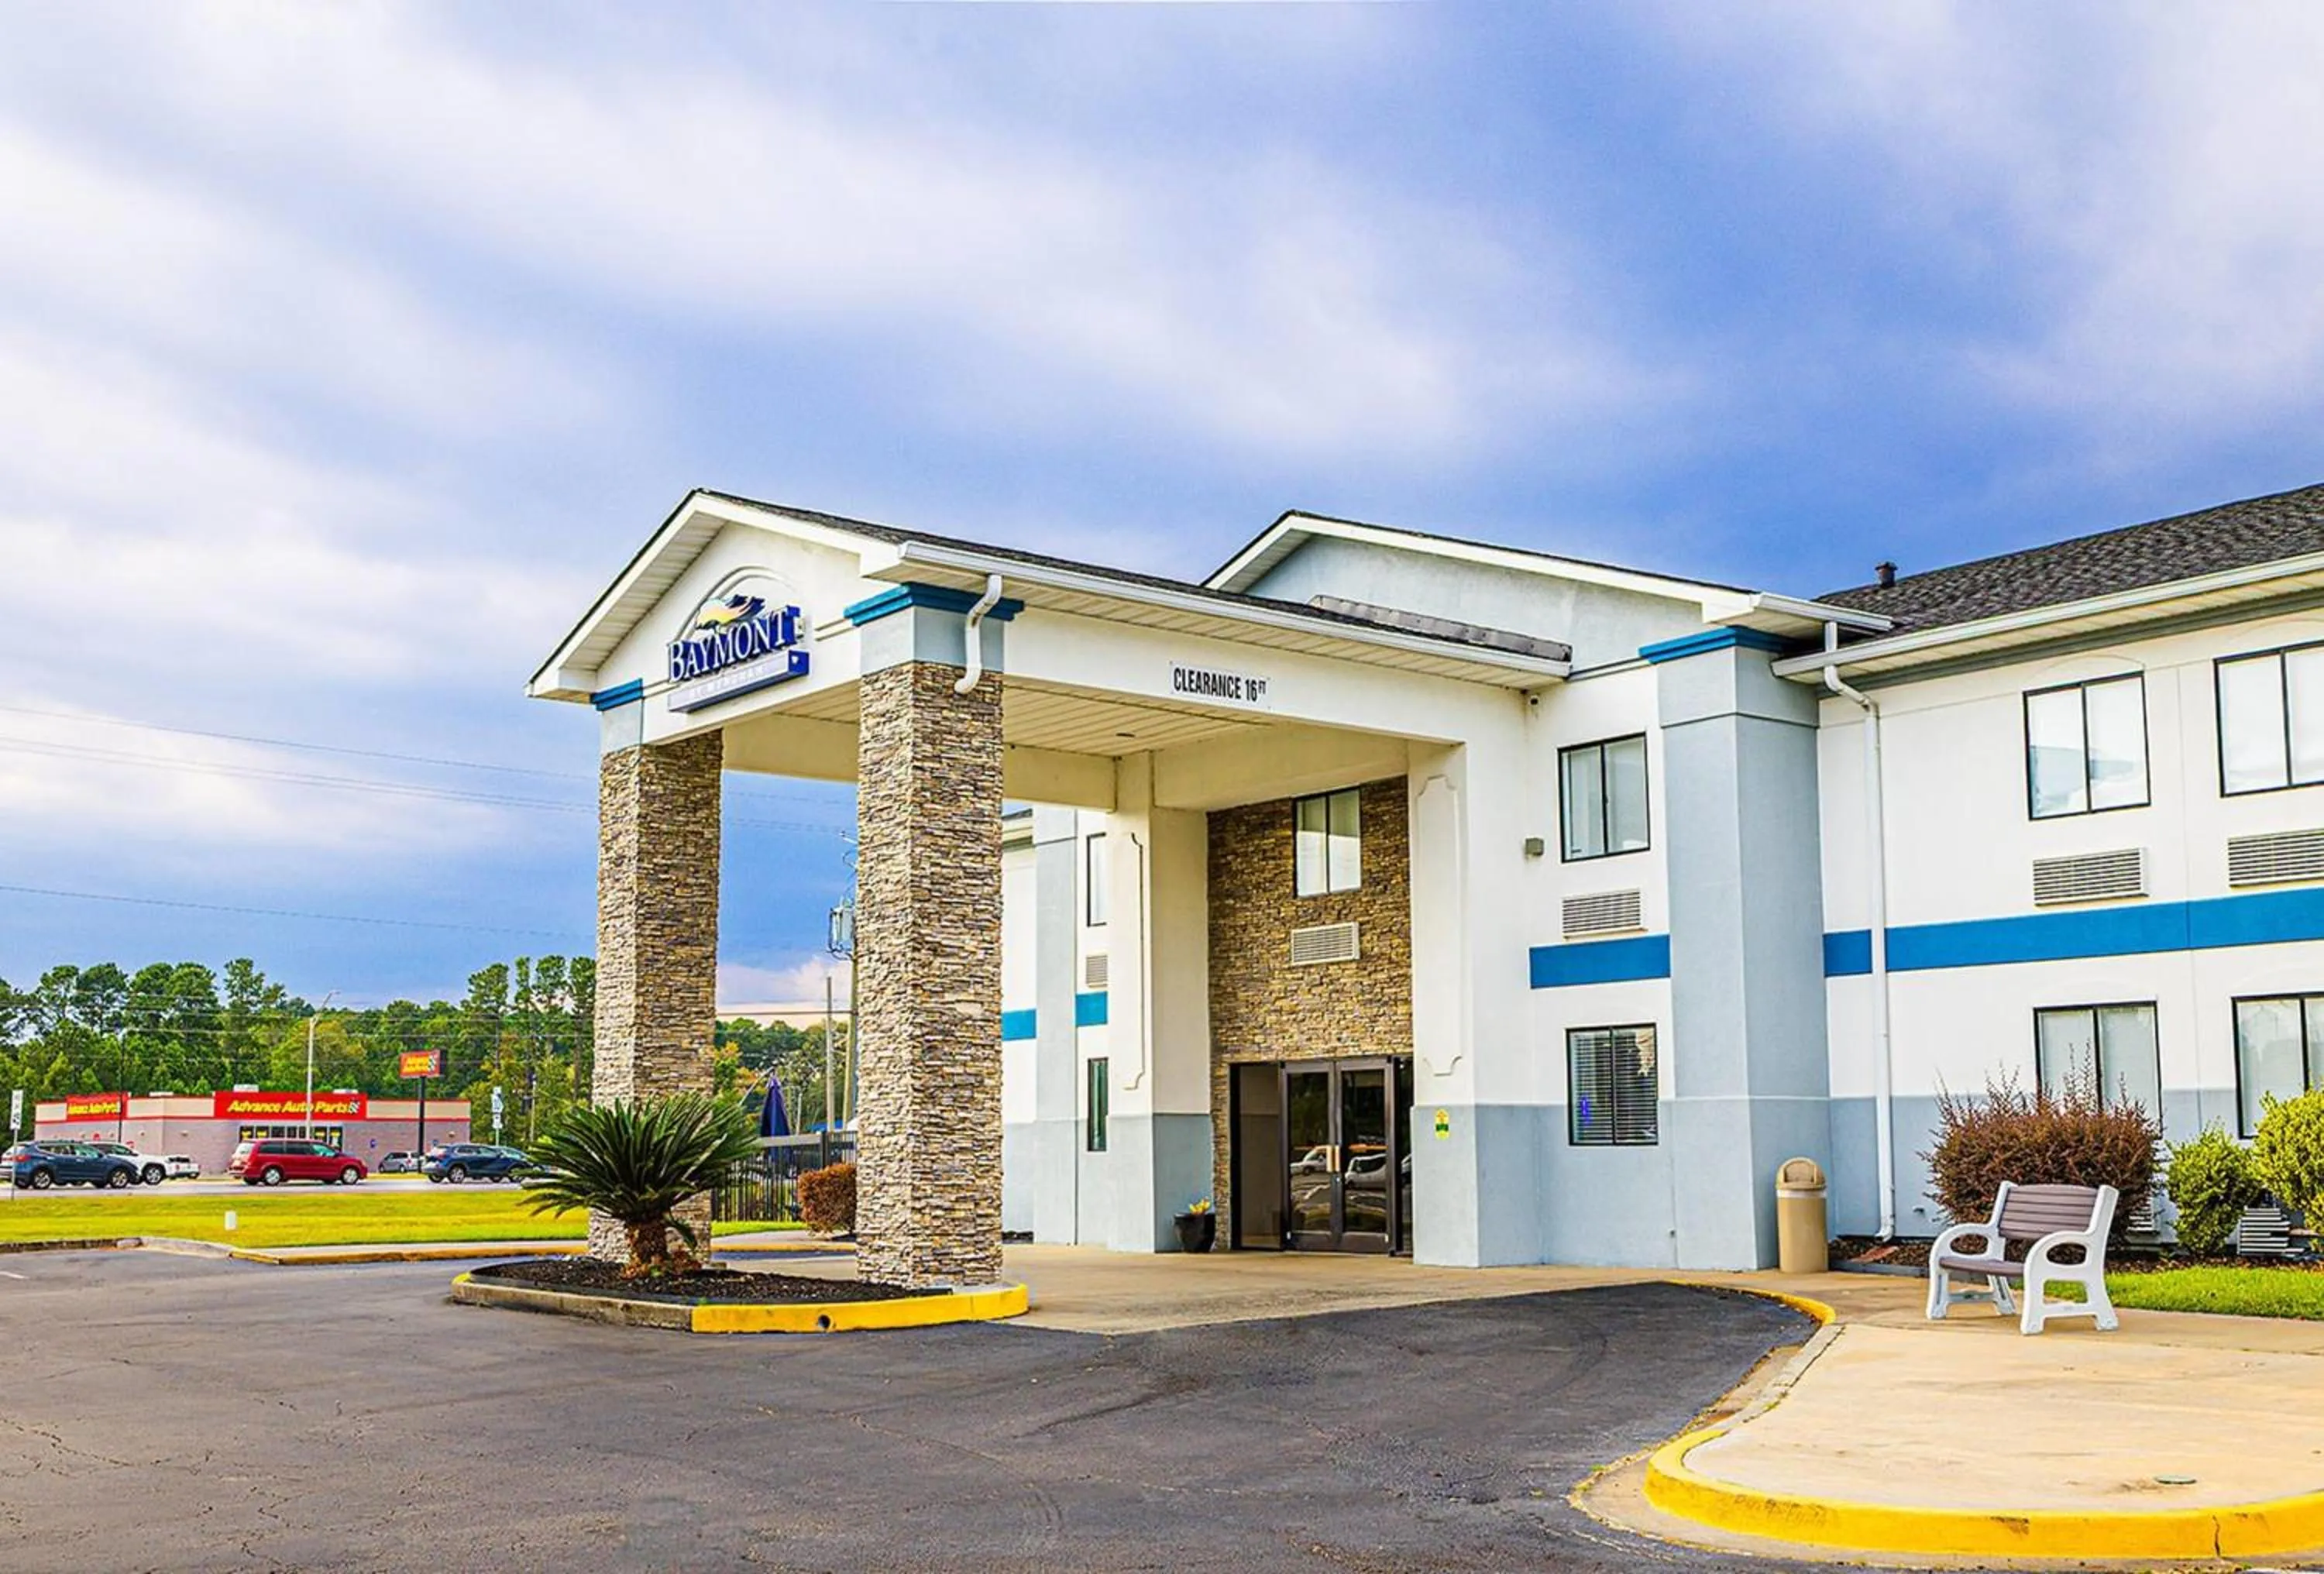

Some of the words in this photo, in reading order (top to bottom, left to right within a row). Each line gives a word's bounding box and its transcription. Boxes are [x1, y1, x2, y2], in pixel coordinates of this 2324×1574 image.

[668, 607, 798, 682] BAYMONT
[1174, 668, 1241, 699] CLEARANCE
[227, 1100, 281, 1113] Advance
[315, 1101, 348, 1113] Parts
